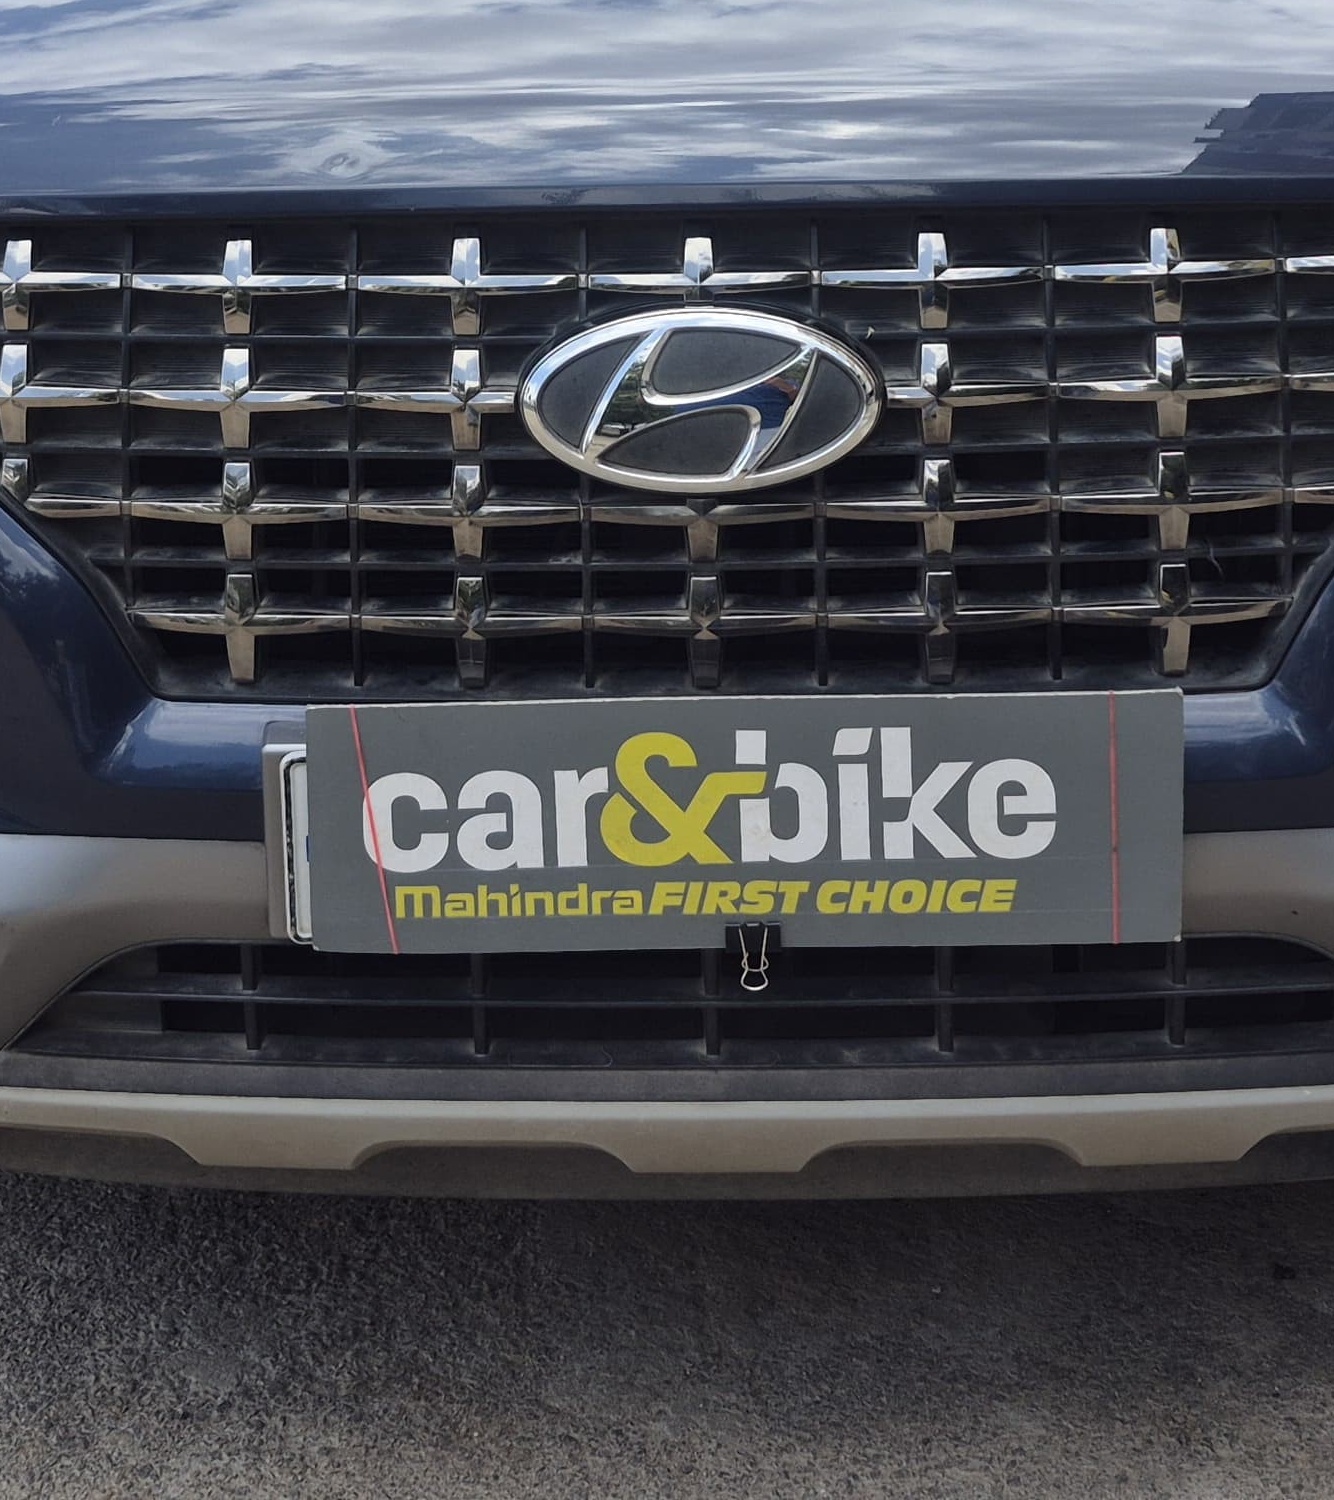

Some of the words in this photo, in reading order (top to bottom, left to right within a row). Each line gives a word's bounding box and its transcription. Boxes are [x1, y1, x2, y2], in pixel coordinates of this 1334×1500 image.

[361, 726, 1056, 873] car&bike
[395, 883, 644, 918] Mahindra
[649, 880, 811, 916] FIRST
[816, 879, 1018, 915] CHOICE
